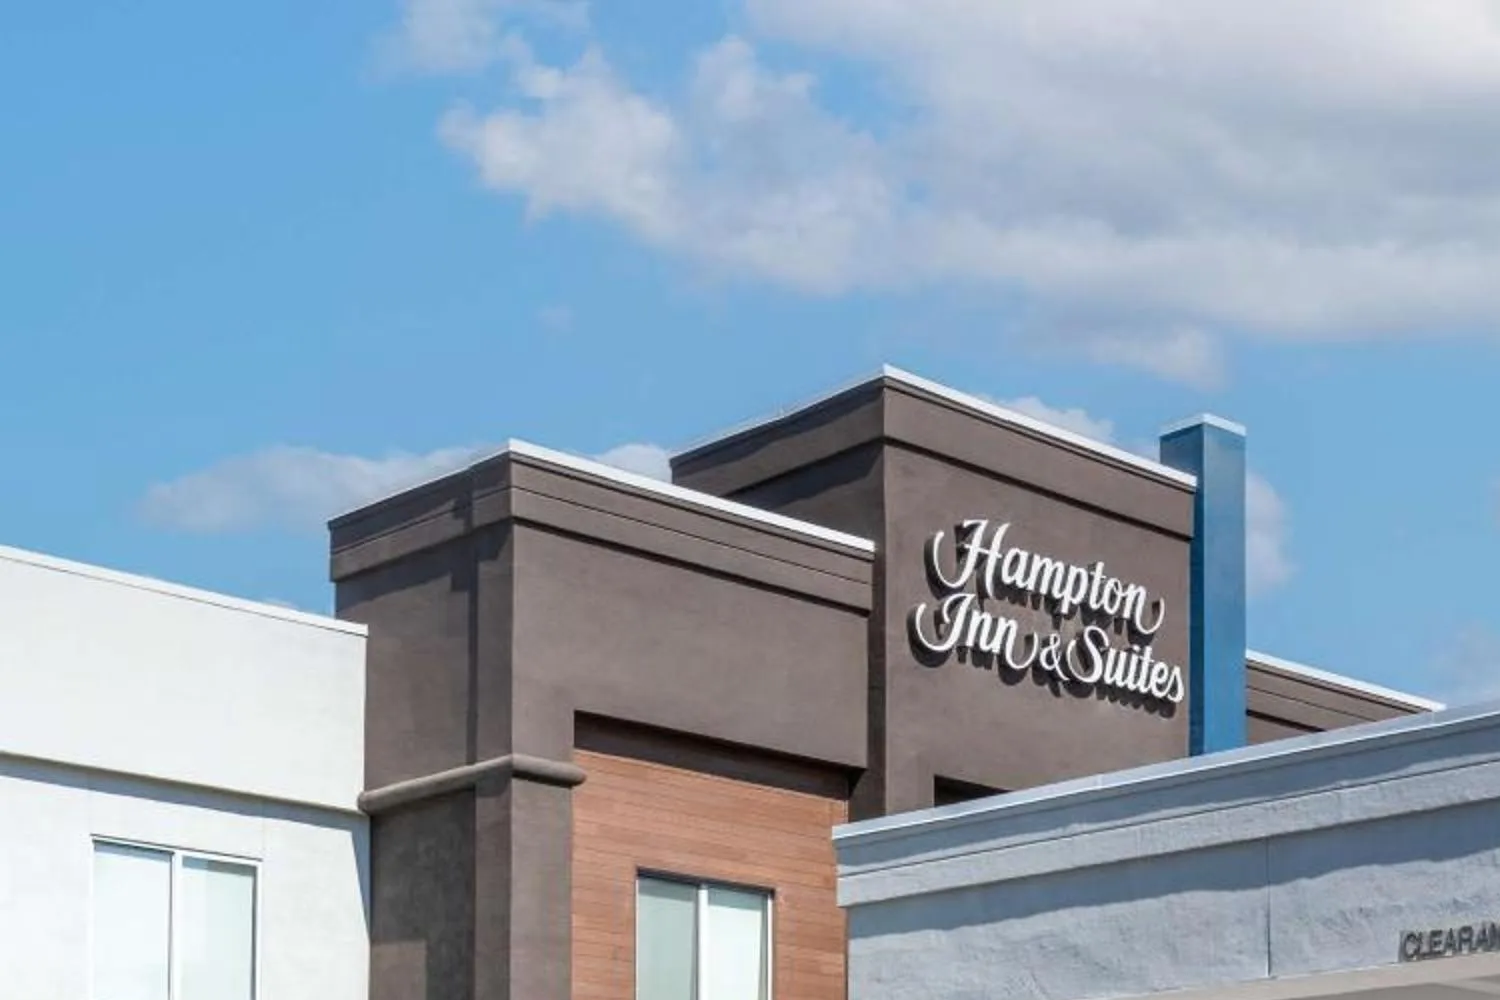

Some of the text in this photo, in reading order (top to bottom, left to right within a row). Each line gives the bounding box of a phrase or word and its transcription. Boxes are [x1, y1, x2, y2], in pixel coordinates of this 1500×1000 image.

[932, 519, 1165, 635] Hampton
[915, 593, 1185, 704] Inn & Suites
